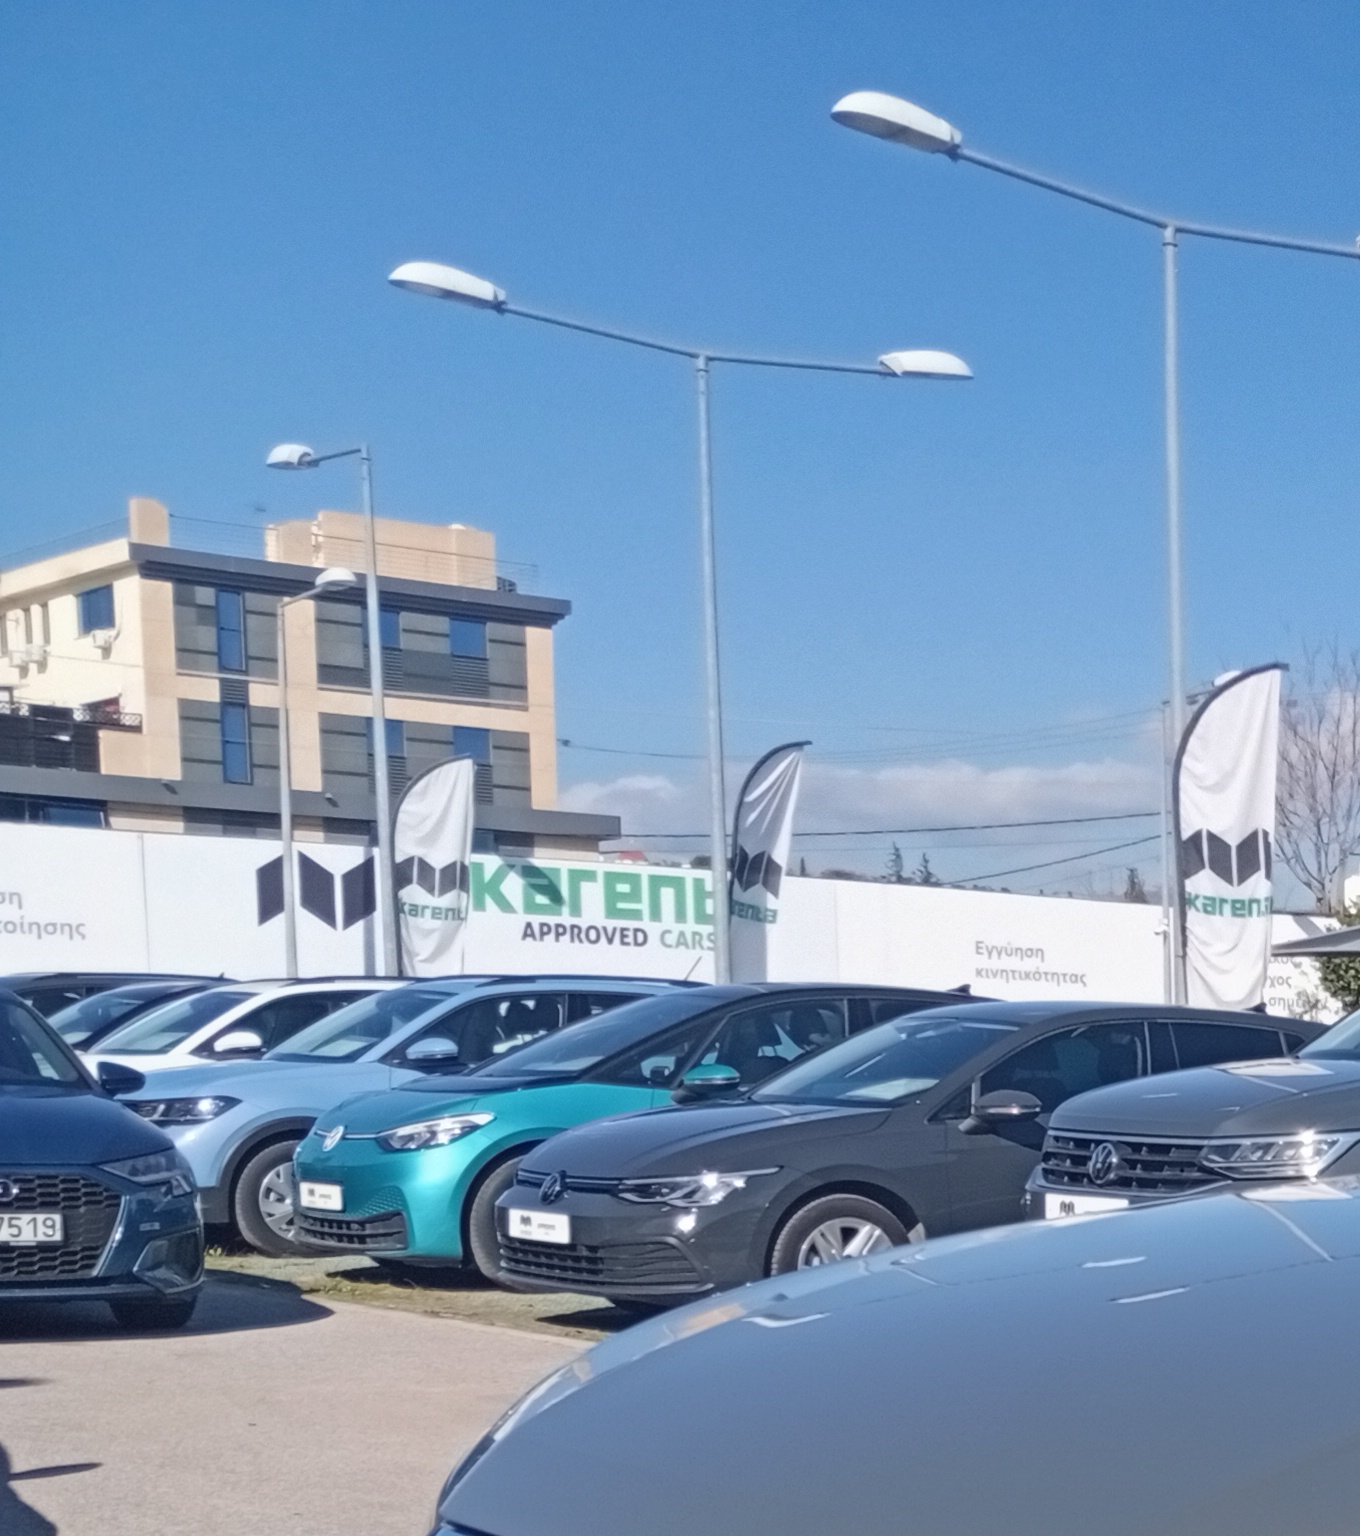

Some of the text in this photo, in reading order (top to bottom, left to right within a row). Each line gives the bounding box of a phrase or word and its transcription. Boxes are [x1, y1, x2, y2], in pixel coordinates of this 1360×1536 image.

[0, 915, 86, 940] οίησης
[521, 921, 649, 947] APPROVED
[975, 940, 1044, 963] Εγγύηση
[975, 966, 1087, 987] κινητικότητας
